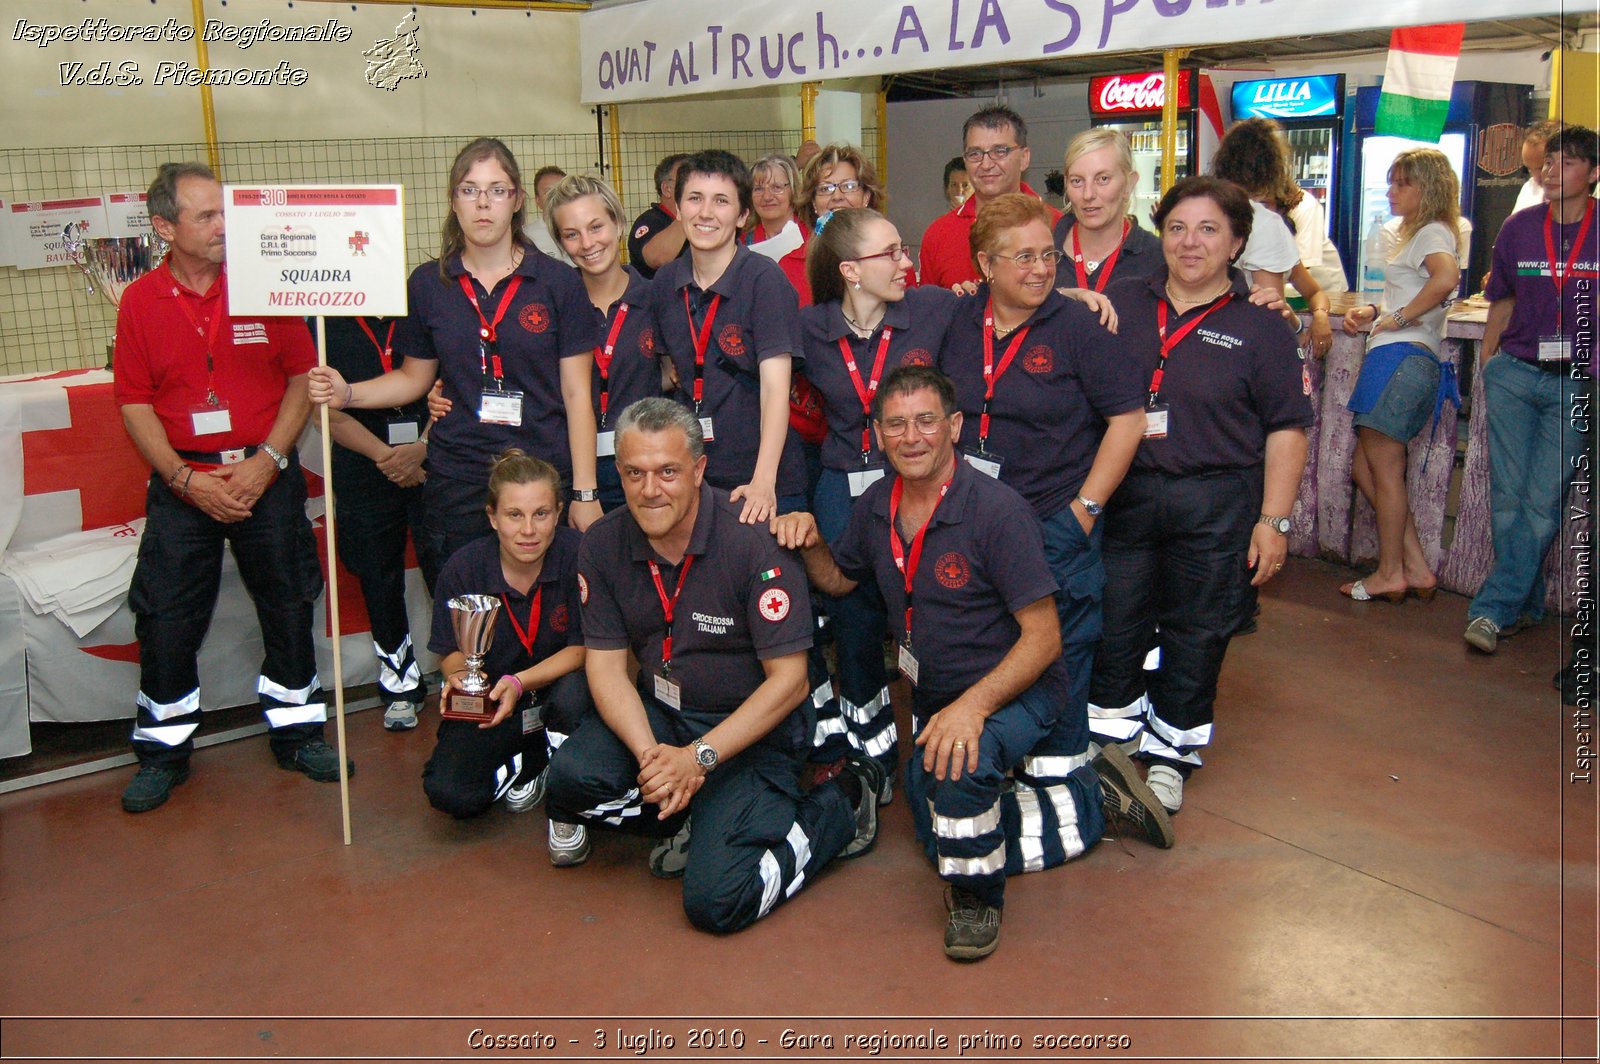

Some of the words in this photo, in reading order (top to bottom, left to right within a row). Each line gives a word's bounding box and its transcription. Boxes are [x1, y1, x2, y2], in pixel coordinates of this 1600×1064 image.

[598, 41, 657, 90] QUAT
[948, 0, 1012, 51] LA
[1253, 81, 1312, 104] LILIA
[261, 189, 287, 206] 30
[260, 233, 278, 241] Gara
[280, 233, 317, 242] Regionale
[281, 241, 288, 249] di
[46, 252, 85, 263] BAVEO
[280, 269, 352, 284] SQUADRA
[268, 291, 367, 307] MERGOZZO
[1197, 329, 1219, 339] CROCE
[1220, 334, 1243, 346] ROSSA
[1202, 335, 1233, 349] ITALIANA
[692, 612, 713, 623] CROCE
[713, 616, 735, 626] ROSSA
[697, 622, 727, 635] ITALIANA
